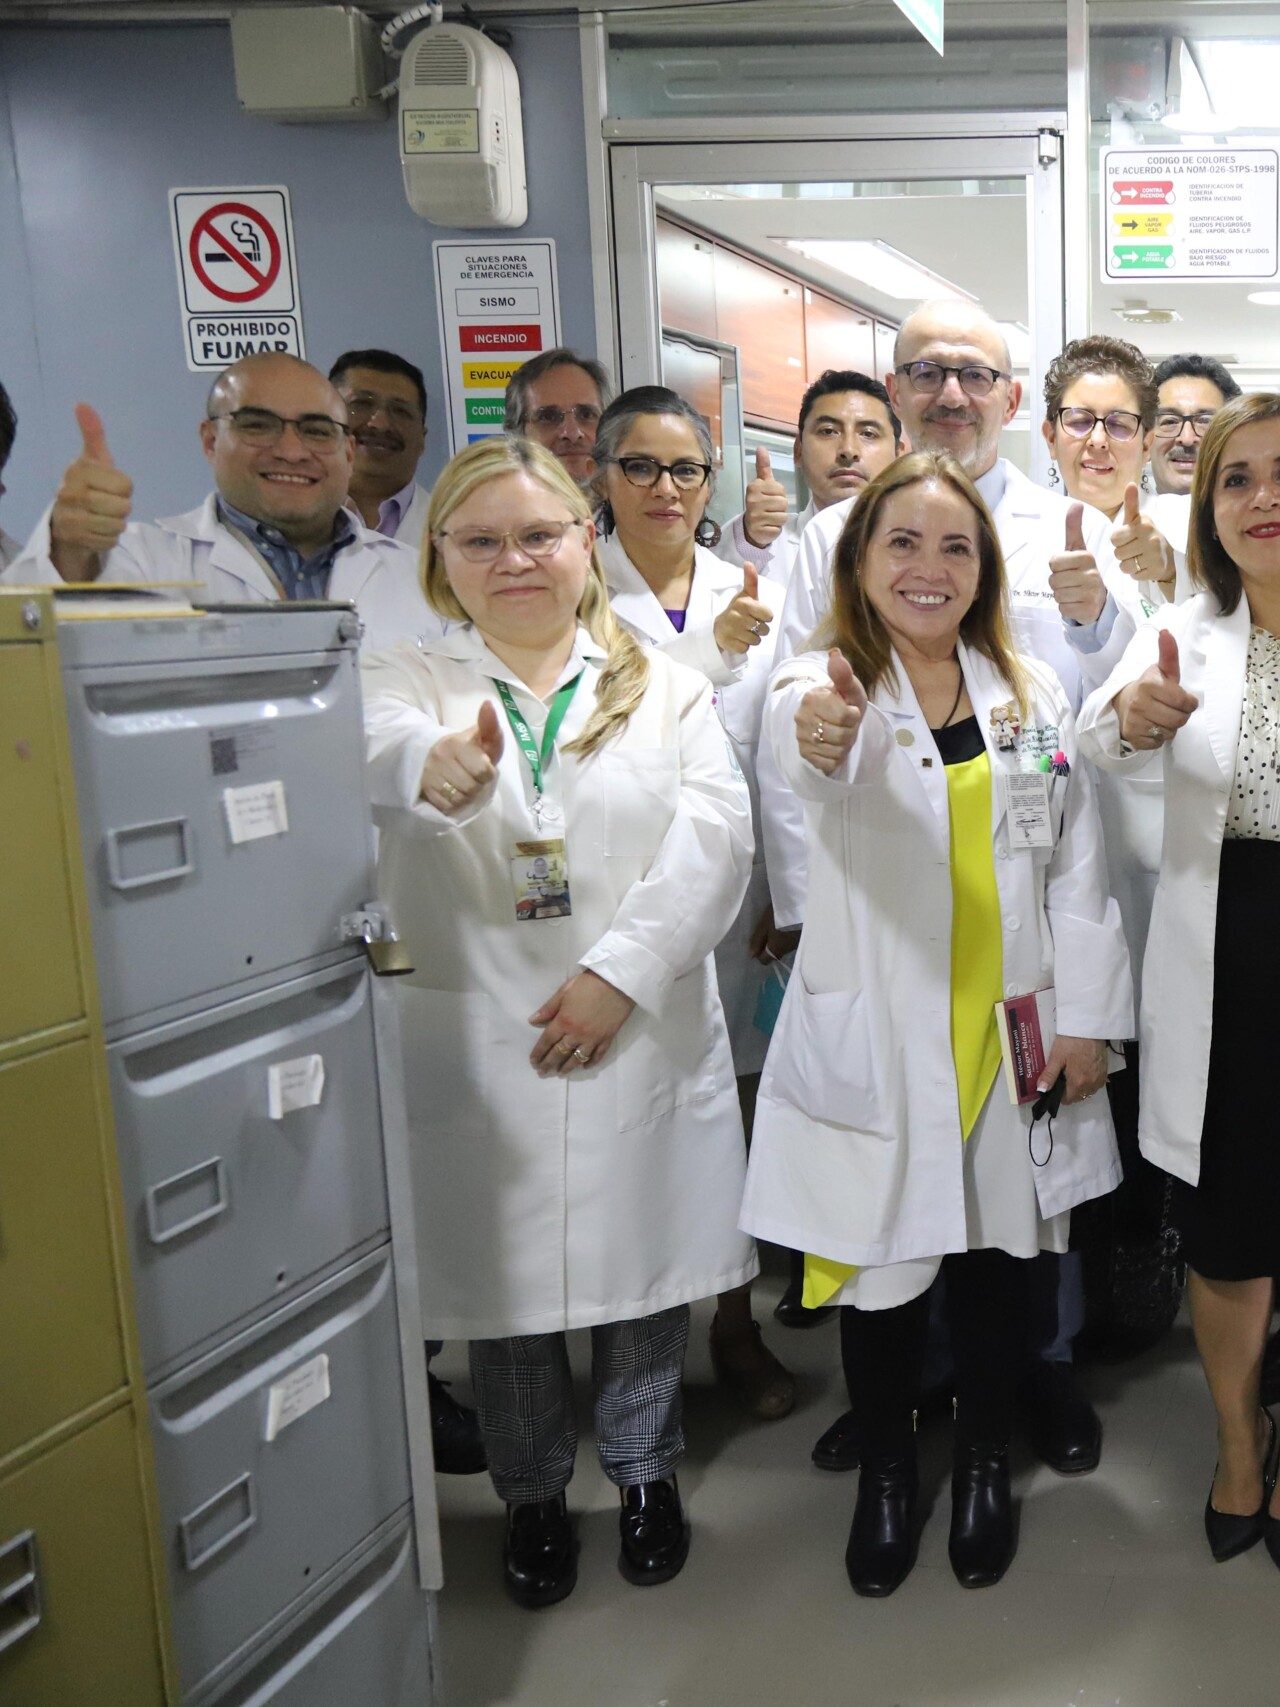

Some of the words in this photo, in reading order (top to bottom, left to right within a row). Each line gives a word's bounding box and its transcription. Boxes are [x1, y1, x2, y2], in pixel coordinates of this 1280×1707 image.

[1182, 156, 1194, 164] DE
[1196, 156, 1236, 164] COLORES
[1122, 166, 1163, 174] ACUERDO
[468, 263, 528, 271] SITUACIONES
[474, 271, 534, 279] EMERGENCIA
[480, 297, 516, 307] SISMO
[197, 322, 290, 337] PROHIBIDO
[474, 333, 527, 343] INCENDIO
[203, 341, 289, 359] FUMAR
[470, 370, 513, 380] EVACUA
[514, 721, 531, 741] IMSS
[1020, 1022, 1029, 1049] blanca
[1016, 1054, 1024, 1076] Héctor
[1024, 1051, 1033, 1079] Sangre
